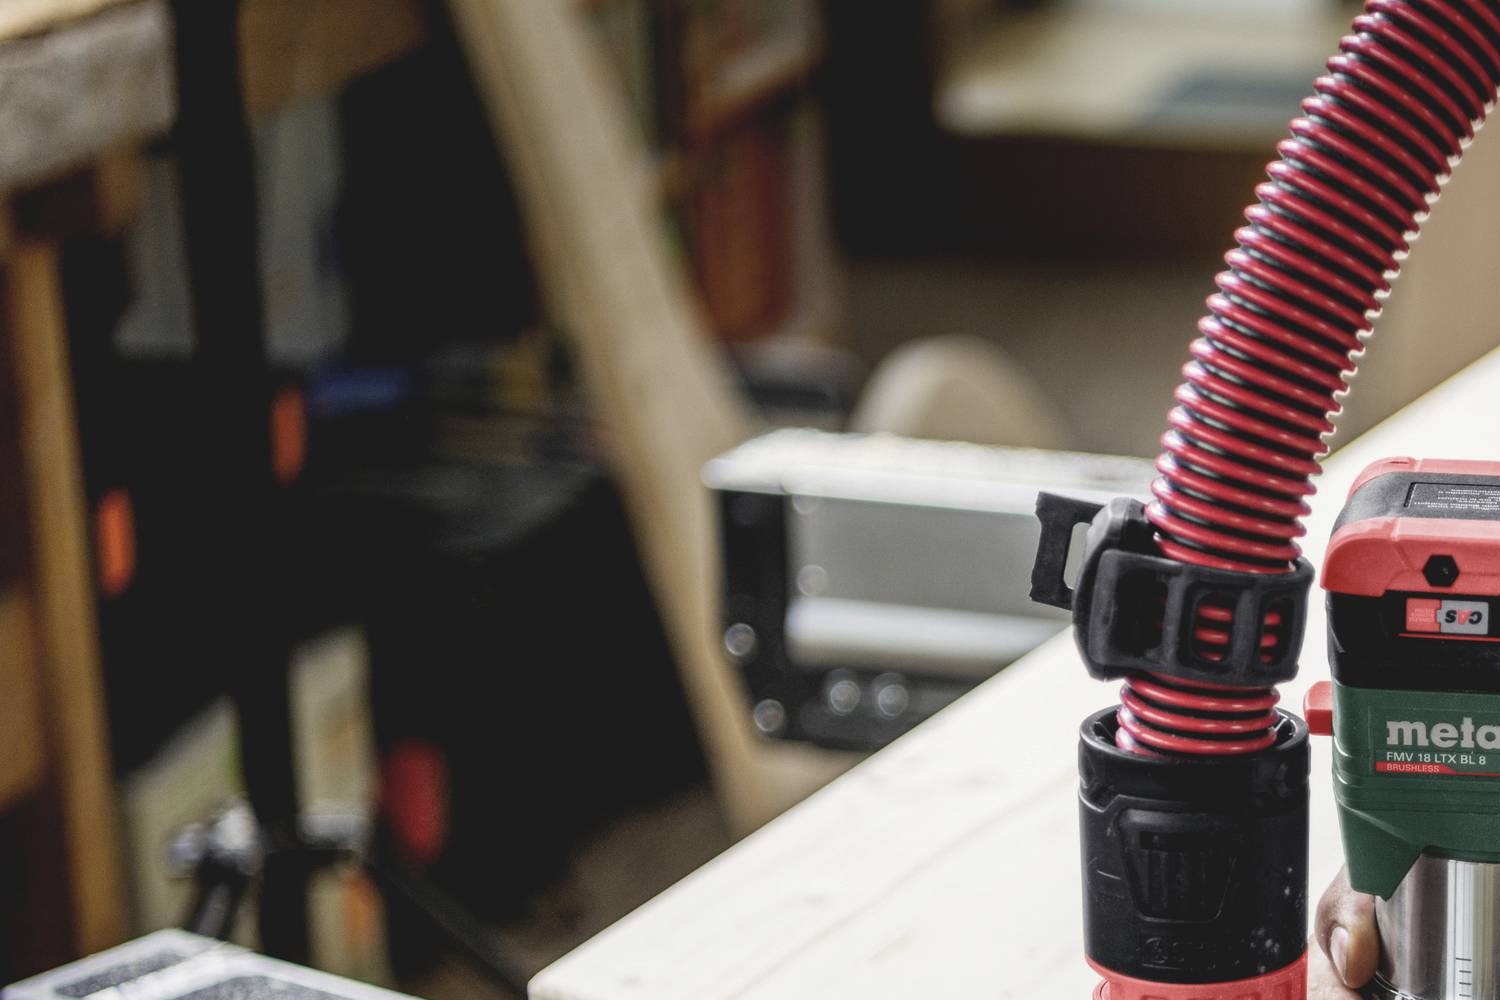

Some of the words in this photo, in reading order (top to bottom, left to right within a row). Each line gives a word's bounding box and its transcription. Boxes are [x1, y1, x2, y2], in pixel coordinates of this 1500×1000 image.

[1445, 609, 1483, 625] CAS
[1386, 752, 1413, 763] FMV
[1418, 753, 1431, 763] 18
[1434, 754, 1457, 764] LTX
[1460, 755, 1475, 765] BL
[1479, 756, 1487, 765] 8
[1386, 763, 1440, 773] BRUSHLESS
